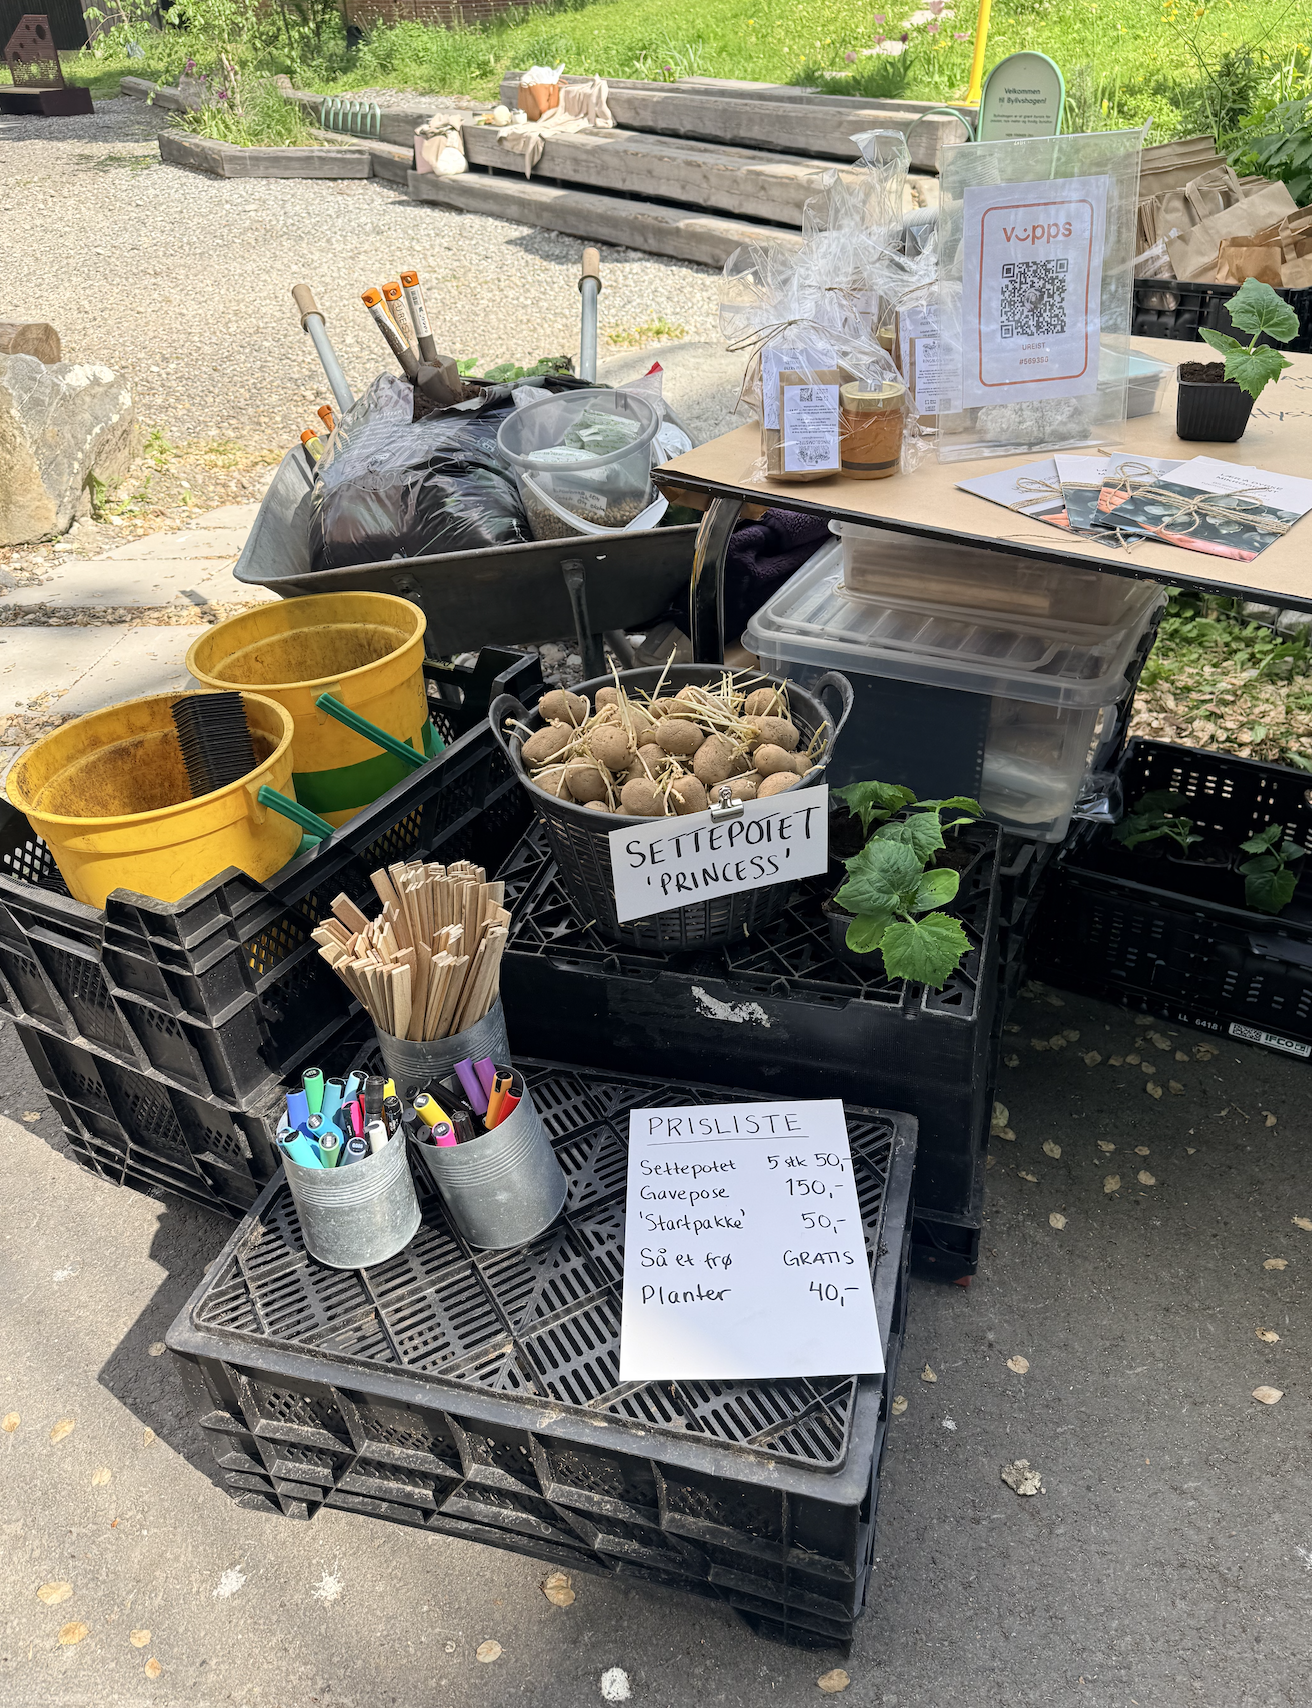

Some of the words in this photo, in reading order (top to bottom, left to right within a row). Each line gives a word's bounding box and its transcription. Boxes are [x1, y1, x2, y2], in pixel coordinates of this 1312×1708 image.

[1007, 97, 1047, 105] Bylivshagen!
[1022, 342, 1046, 351] UREIST
[625, 806, 821, 869] SETTEPOTET
[1264, 1034, 1294, 1048] IFCO
[648, 1113, 802, 1137] PRISLISTE
[640, 1159, 737, 1179] Settepotet
[767, 1155, 780, 1170] 5
[784, 1155, 808, 1168] stk
[814, 1152, 852, 1172] 50,-
[640, 1185, 730, 1206] Gavepose
[785, 1178, 844, 1199] 150,-
[801, 1211, 847, 1234] 50,-
[640, 1247, 668, 1268] Så
[675, 1253, 696, 1267] et
[704, 1252, 733, 1270] frø
[783, 1249, 855, 1267] GRATIS
[641, 1283, 732, 1305] Planter
[809, 1280, 860, 1307] 40,-
